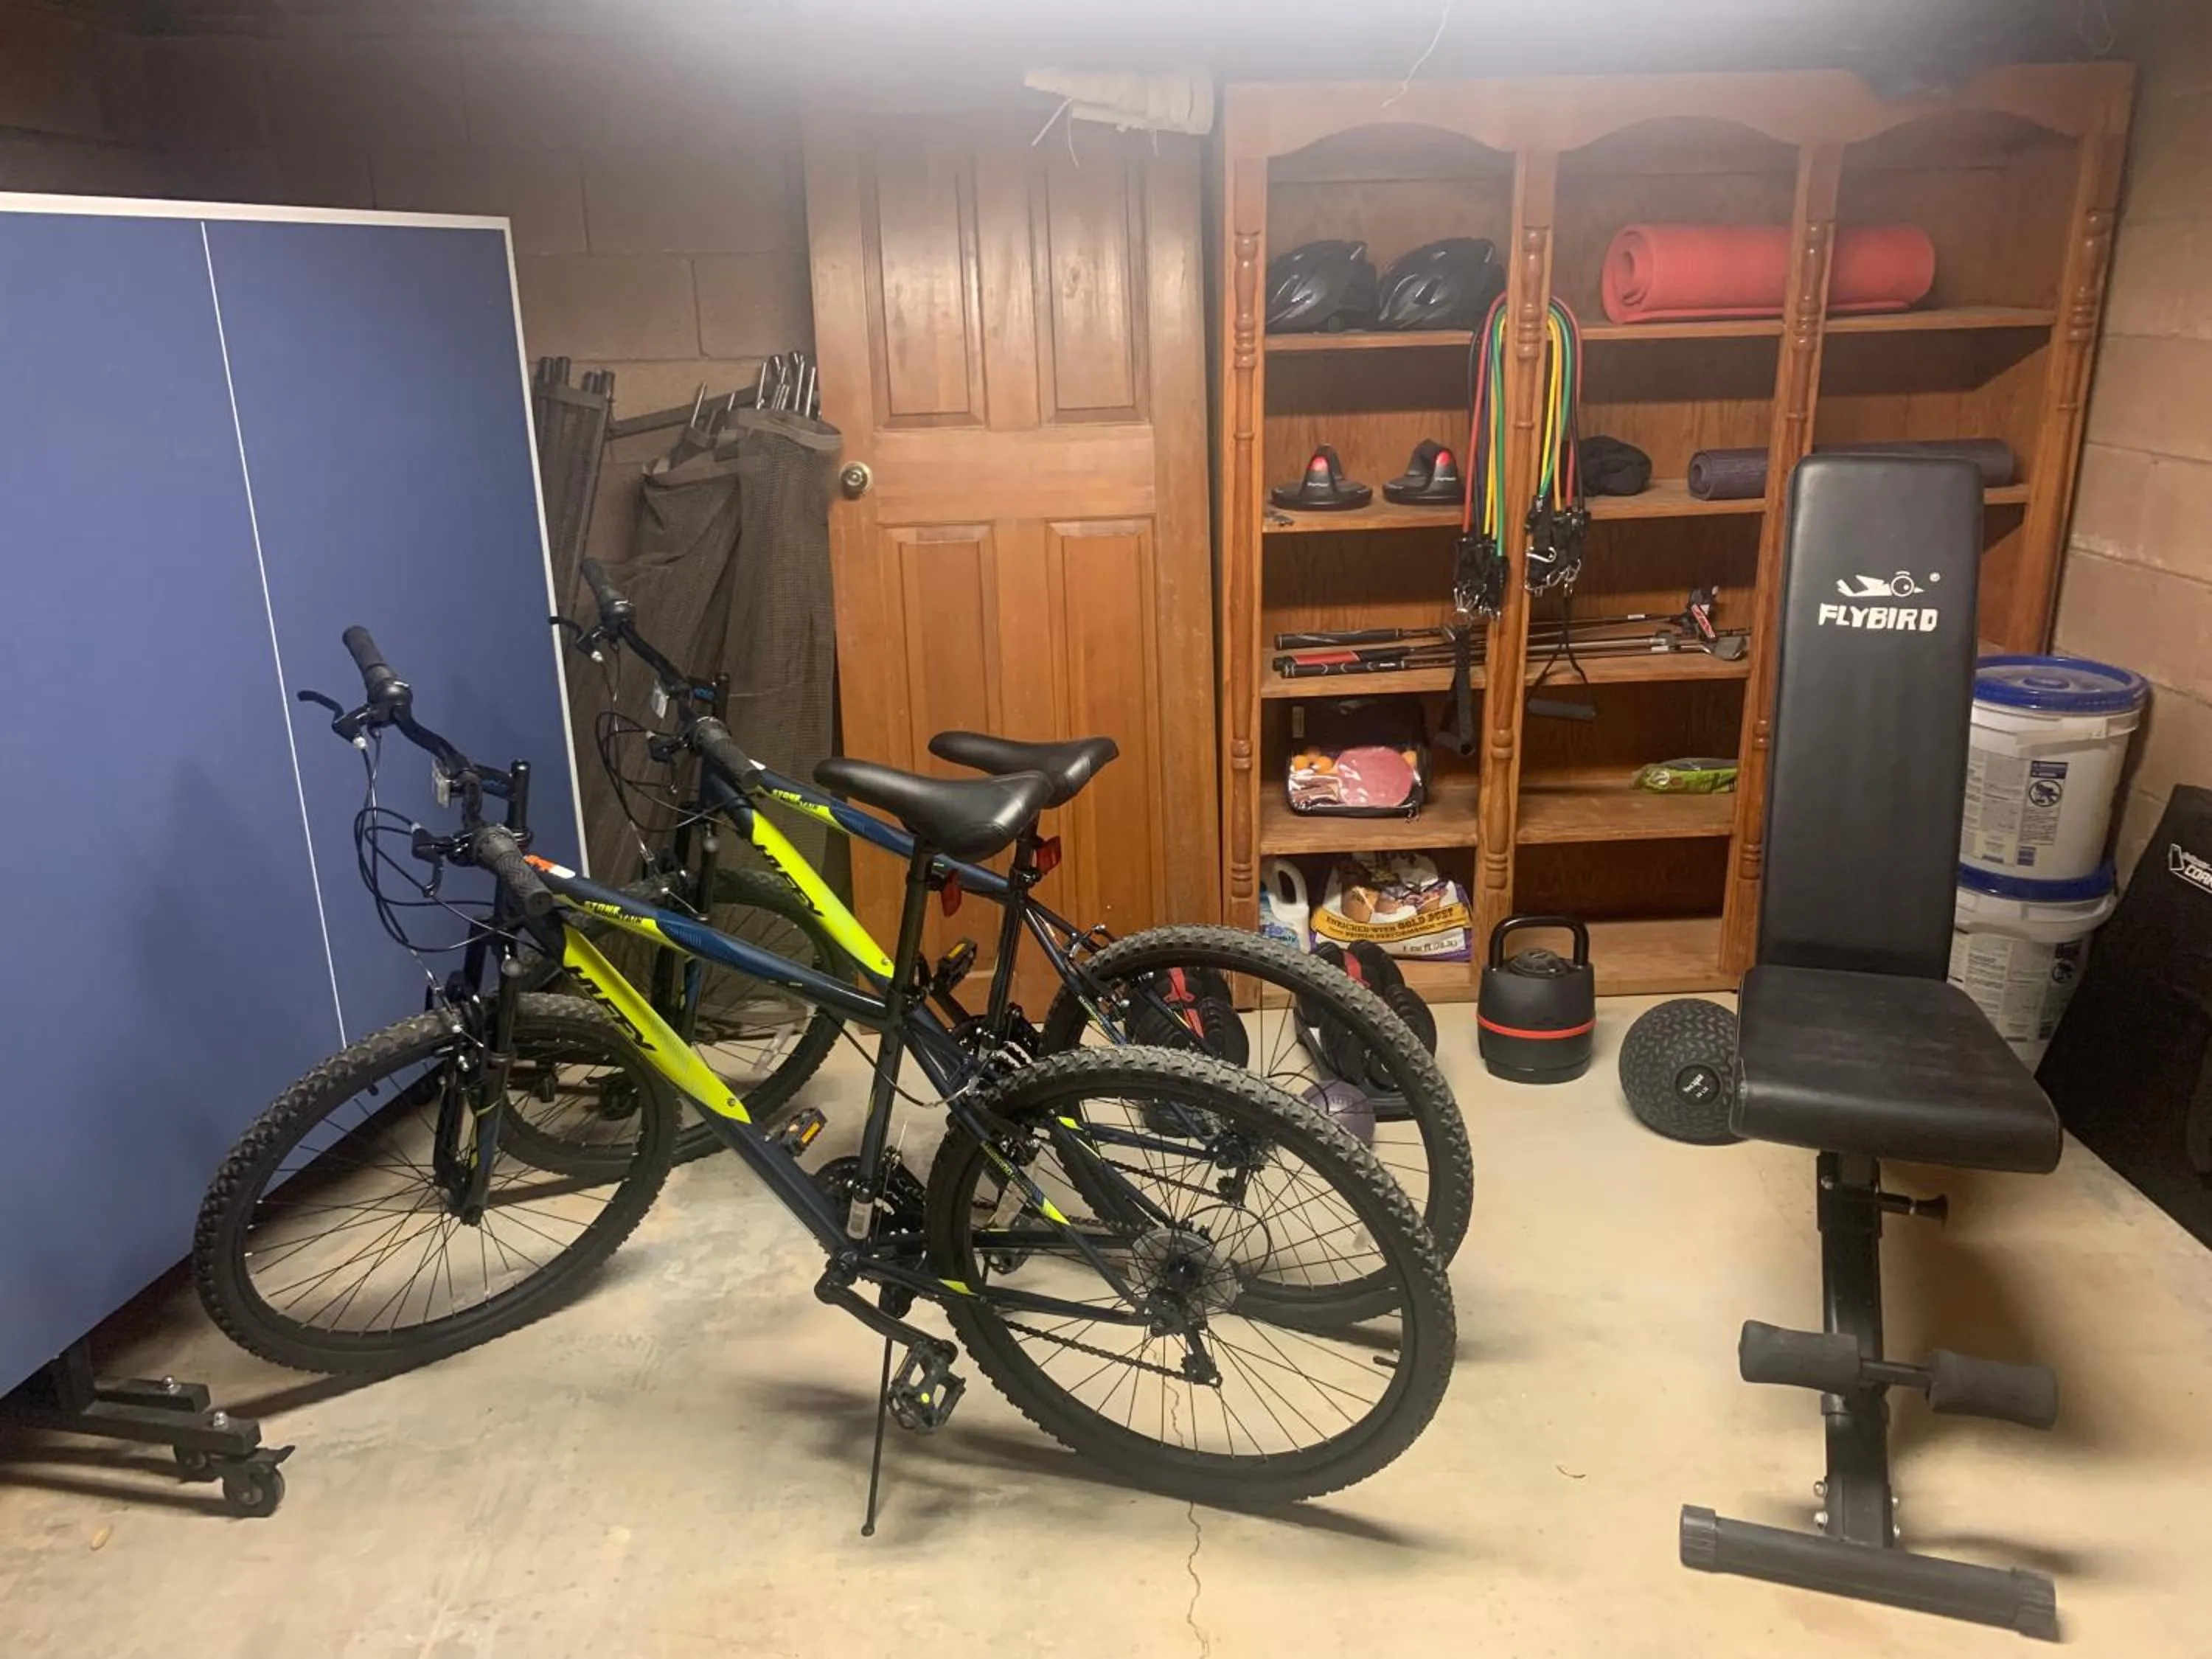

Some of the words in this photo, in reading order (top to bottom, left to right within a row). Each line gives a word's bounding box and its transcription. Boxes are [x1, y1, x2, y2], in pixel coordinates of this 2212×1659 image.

[1818, 602, 1938, 632] FLYBIRD
[1397, 916, 1425, 931] GOLD
[1427, 906, 1454, 922] DUST
